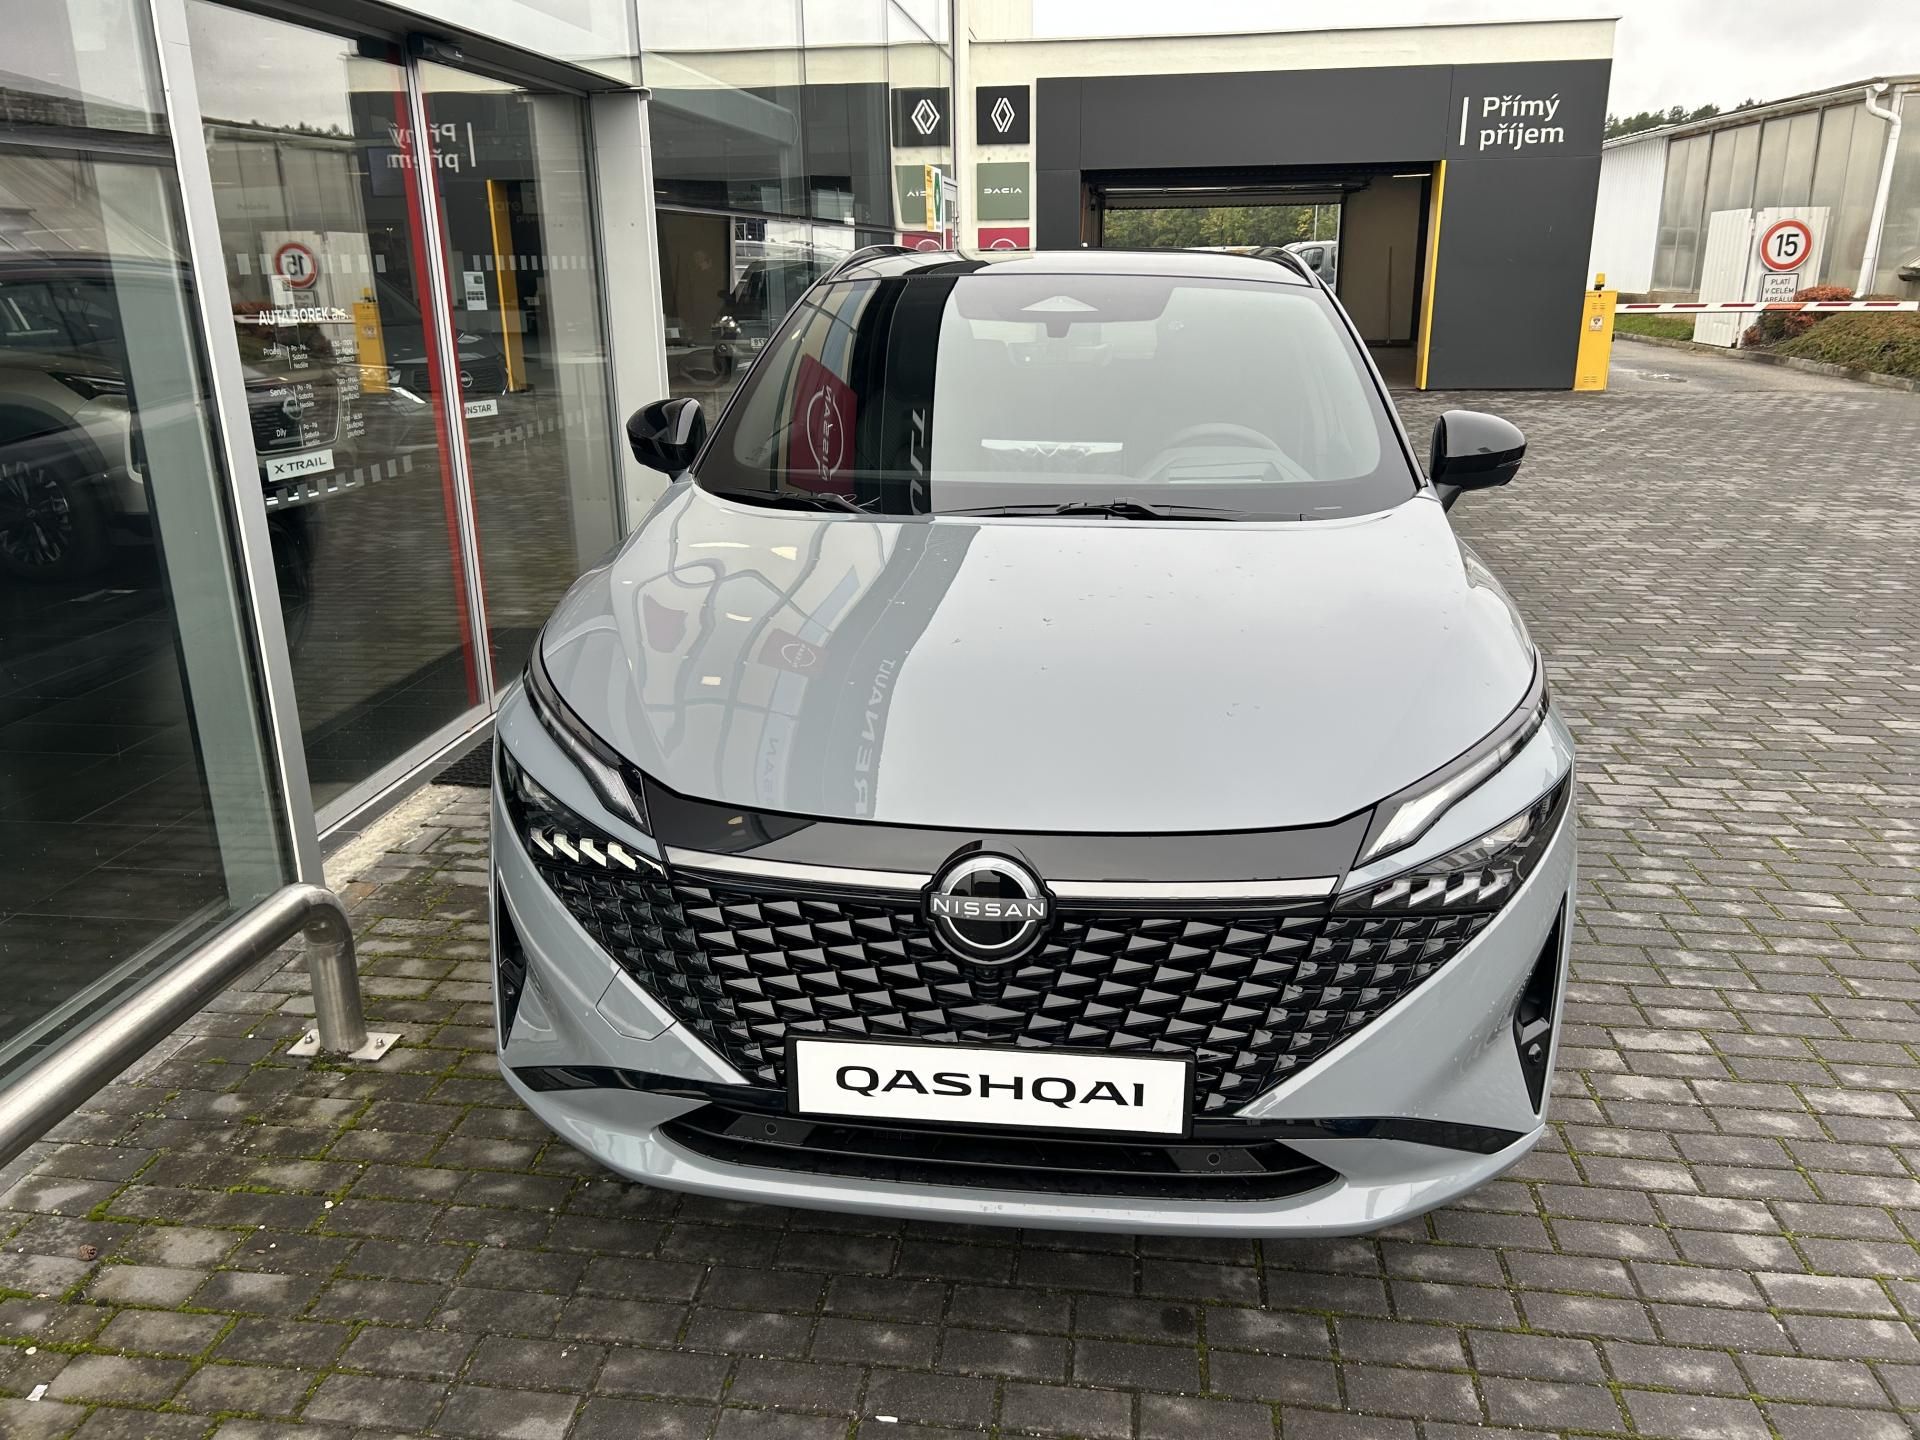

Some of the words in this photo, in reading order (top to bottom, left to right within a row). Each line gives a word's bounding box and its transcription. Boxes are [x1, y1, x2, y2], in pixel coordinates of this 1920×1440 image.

[1482, 93, 1560, 121] Přímý
[1479, 123, 1564, 150] příjem
[1776, 233, 1799, 256] 15
[1770, 277, 1791, 285] PLATÍ
[1771, 285, 1795, 294] CELÉM
[259, 309, 289, 326] AUTA
[292, 307, 330, 323] BOREK
[270, 388, 287, 398] Servis
[287, 457, 327, 472] TRAIL
[932, 897, 1044, 918] NISSAN
[836, 1065, 1144, 1109] QASHQAI
